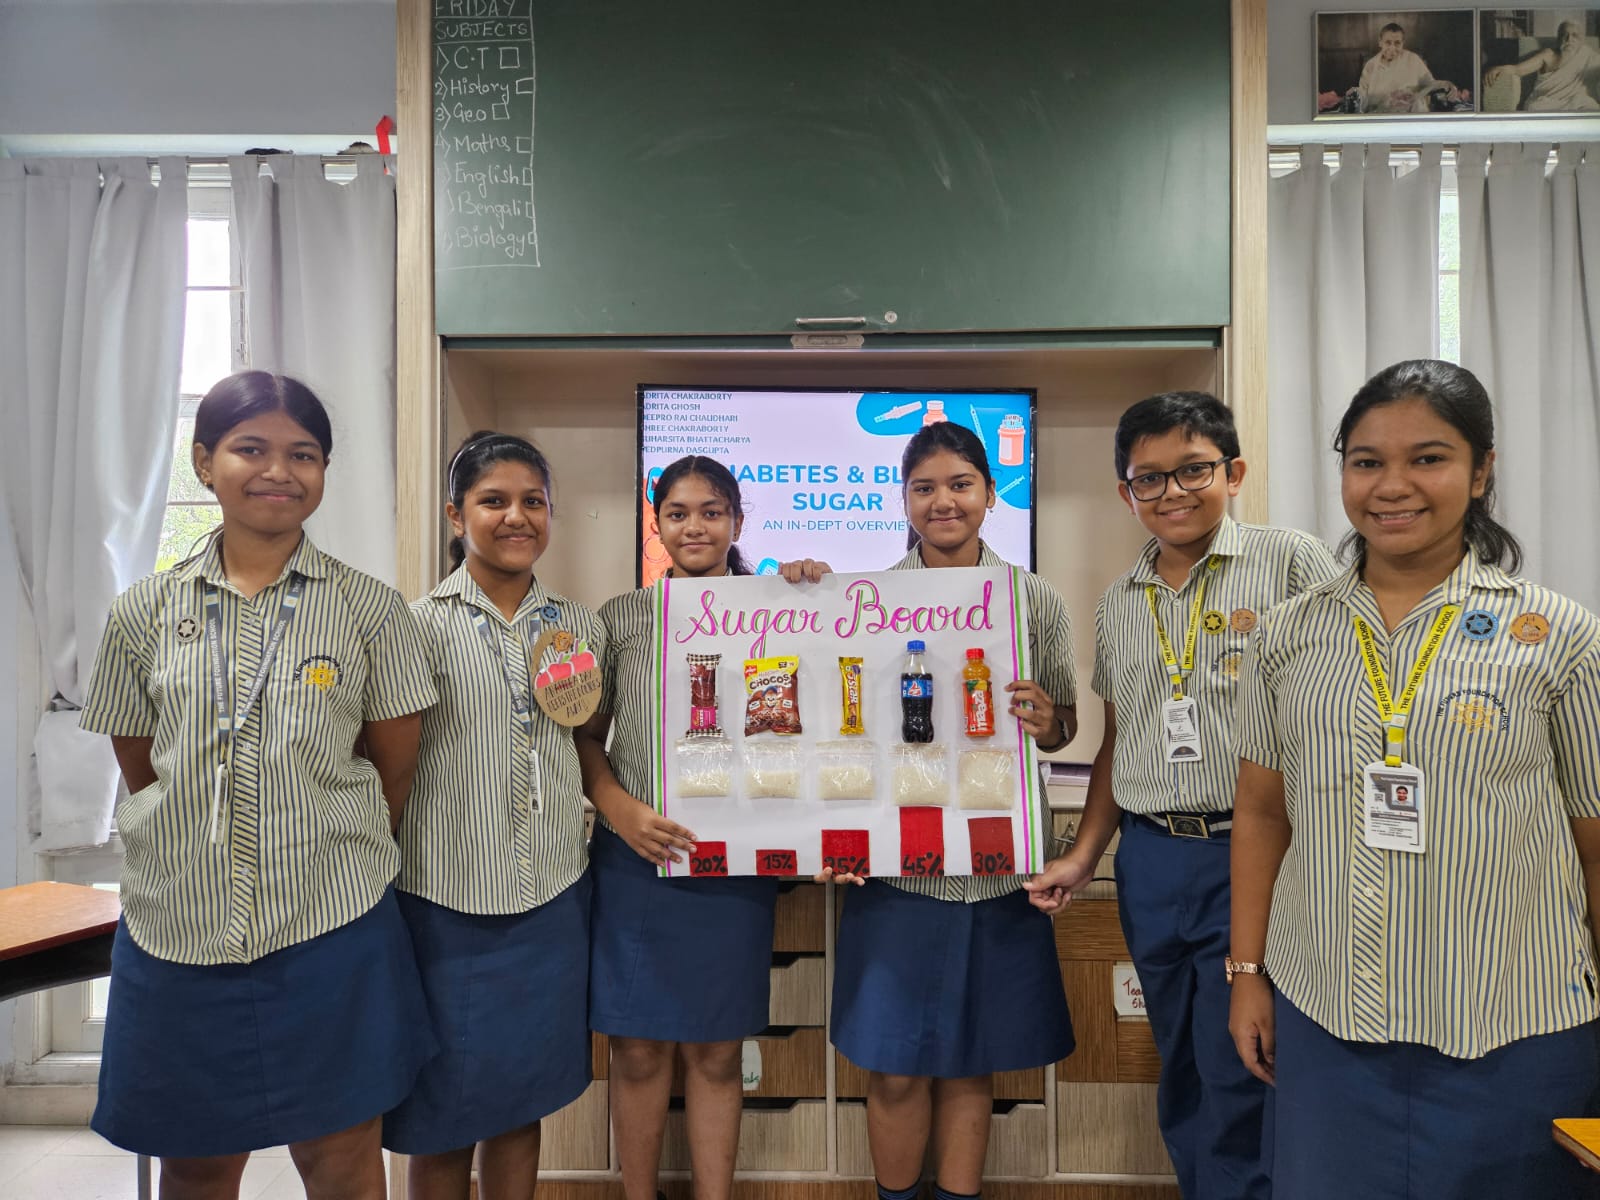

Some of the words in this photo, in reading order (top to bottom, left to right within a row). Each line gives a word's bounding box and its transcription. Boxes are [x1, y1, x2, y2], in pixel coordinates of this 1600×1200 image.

[436, 0, 516, 17] FRIDAY
[434, 20, 528, 40] SUBJECTS
[450, 73, 510, 105] History
[453, 102, 487, 123] Geo
[453, 132, 511, 155] Maths
[455, 161, 519, 198] English
[458, 191, 522, 231] Bengali
[455, 225, 525, 258] Biology
[644, 392, 670, 400] DRITA
[671, 392, 732, 400] CHAKRABORTY
[644, 402, 670, 410] DRITA
[686, 446, 730, 454] DASGUPTA
[730, 464, 839, 484] IABETES
[847, 465, 865, 484] &
[873, 465, 903, 485] BL
[792, 492, 883, 511] SUGAR
[763, 520, 783, 531] AN
[787, 520, 843, 531] IN-DEPT
[846, 520, 908, 532] OVERVIE
[674, 589, 824, 659] Sugar
[834, 579, 994, 639] Board
[1364, 640, 1380, 676] FOUNDATION
[1400, 693, 1411, 710] THE
[1406, 672, 1423, 696] FUTURE
[1417, 634, 1441, 674] FOUNDATION
[1436, 610, 1454, 634] SCHOOL
[749, 673, 791, 690] CHOCOS
[1374, 676, 1388, 702] FUTURE
[1382, 701, 1392, 716] THE
[692, 855, 727, 873] 20%
[763, 853, 793, 870] 15%
[902, 852, 945, 875] 45%
[973, 852, 1012, 874] 30%
[1122, 977, 1144, 996] Tea
